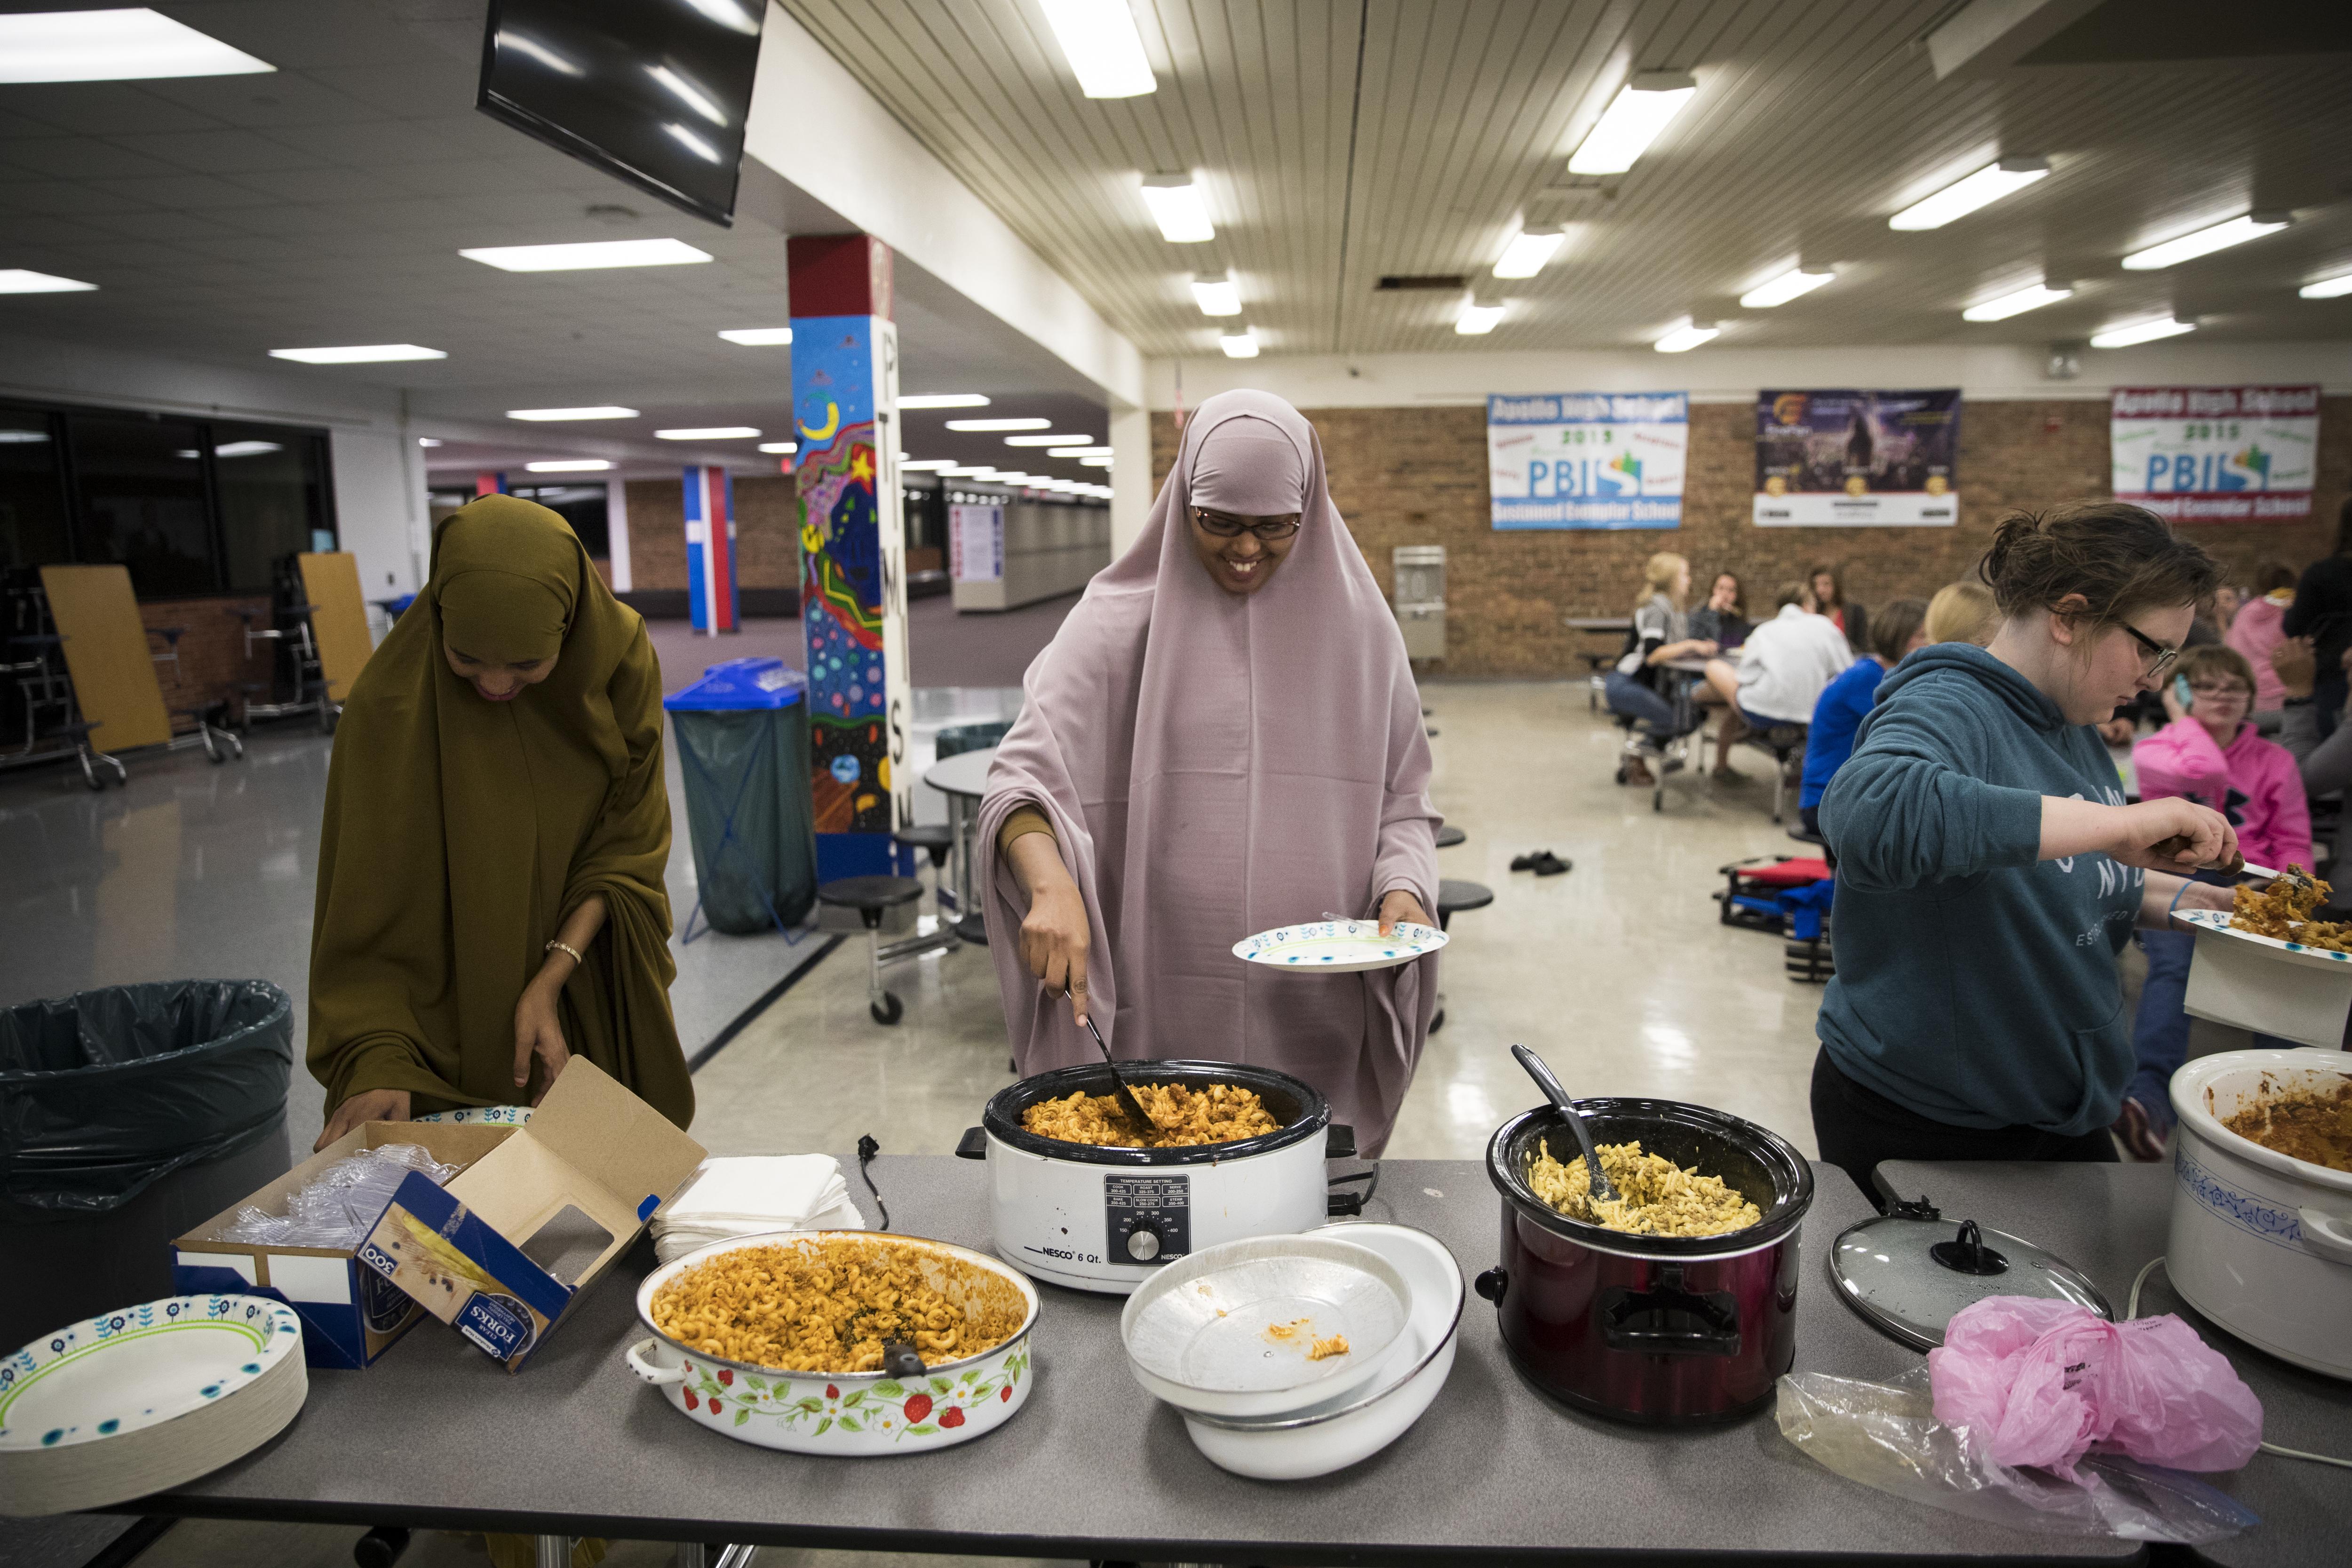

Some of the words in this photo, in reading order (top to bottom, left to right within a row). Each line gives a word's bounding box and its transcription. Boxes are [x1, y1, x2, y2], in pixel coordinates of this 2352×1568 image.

[1529, 460, 1643, 497] PBIS
[2146, 453, 2273, 492] PBIS
[366, 1248, 395, 1274] 300
[1087, 1254, 1101, 1264] Qt.
[470, 1306, 516, 1344] FORKS
[479, 1324, 497, 1340] CLEAR
